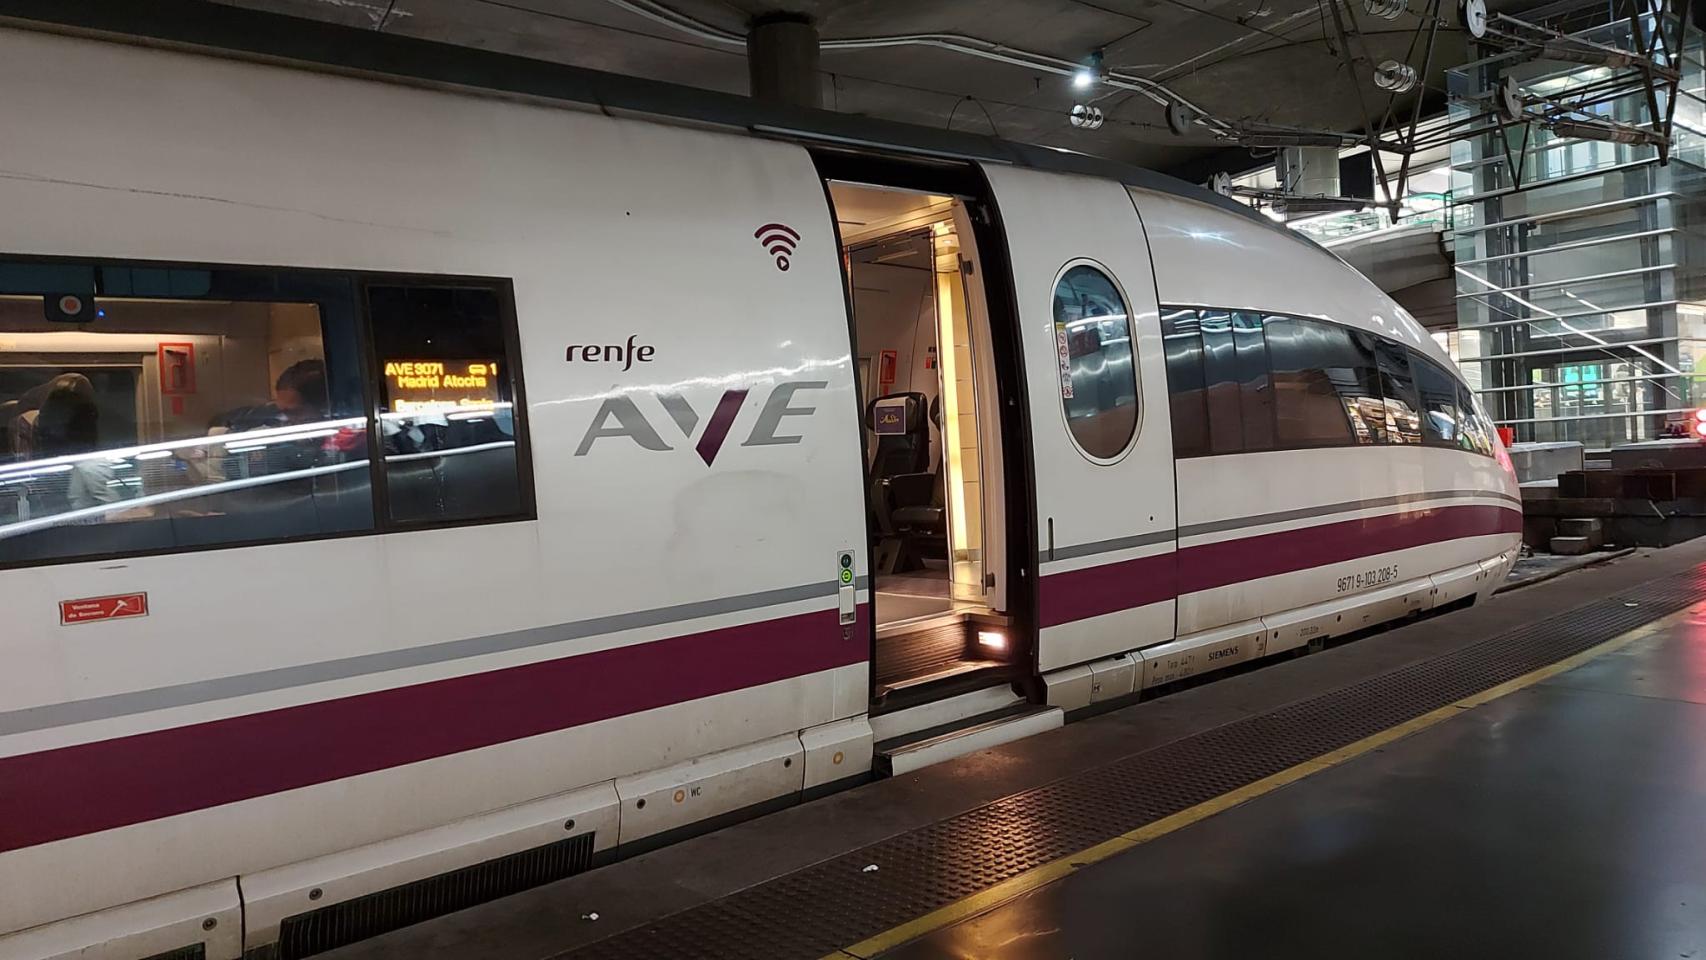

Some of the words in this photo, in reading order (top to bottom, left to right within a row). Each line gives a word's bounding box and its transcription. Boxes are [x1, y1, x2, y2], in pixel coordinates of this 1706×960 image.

[565, 335, 655, 372] renfe
[385, 363, 413, 376] AVE
[398, 375, 440, 388] Madrid
[443, 375, 487, 388] Atocha
[574, 381, 828, 468] AVE
[1337, 575, 1355, 592] 9671
[1208, 647, 1239, 662] SIEMENS
[690, 786, 702, 798] WC
